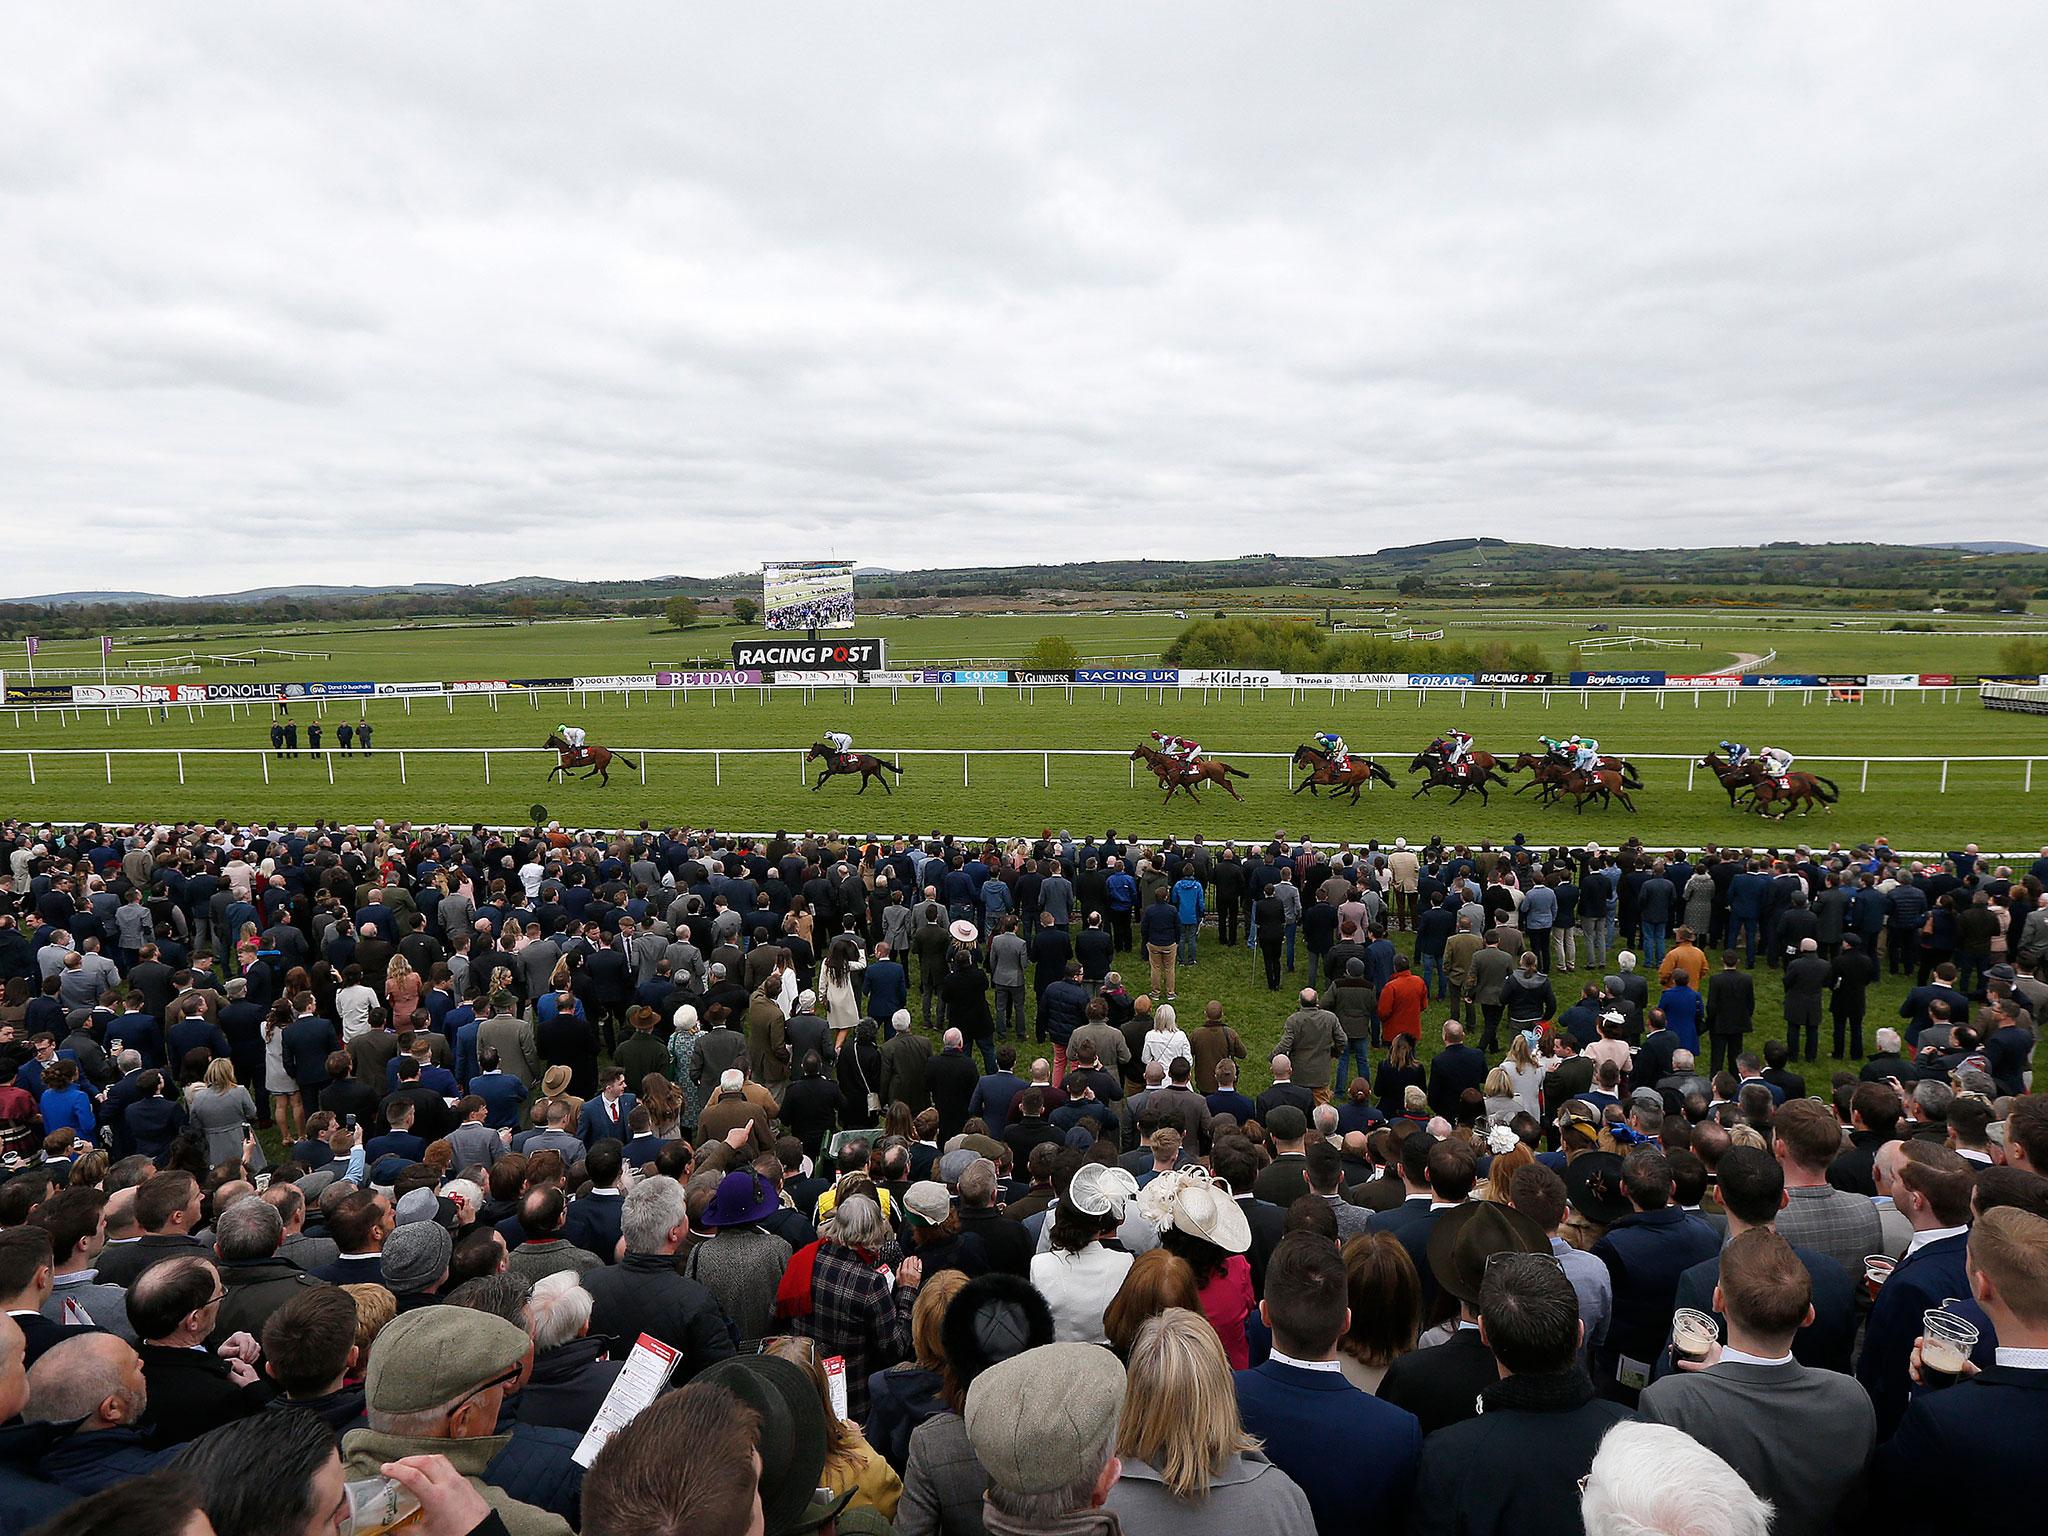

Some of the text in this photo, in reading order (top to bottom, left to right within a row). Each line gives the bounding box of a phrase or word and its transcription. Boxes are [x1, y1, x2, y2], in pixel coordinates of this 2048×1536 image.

[738, 646, 872, 665] RACING POST
[670, 671, 748, 685] BETDAO
[965, 672, 998, 680] COX'S
[1079, 671, 1176, 681] RACING UK
[1210, 671, 1269, 687] Kildare
[1480, 673, 1546, 684] RACING POST
[1587, 675, 1650, 686] BoyleSports
[1758, 677, 1802, 686] BoyleSports
[208, 684, 281, 697] DONOHUE
